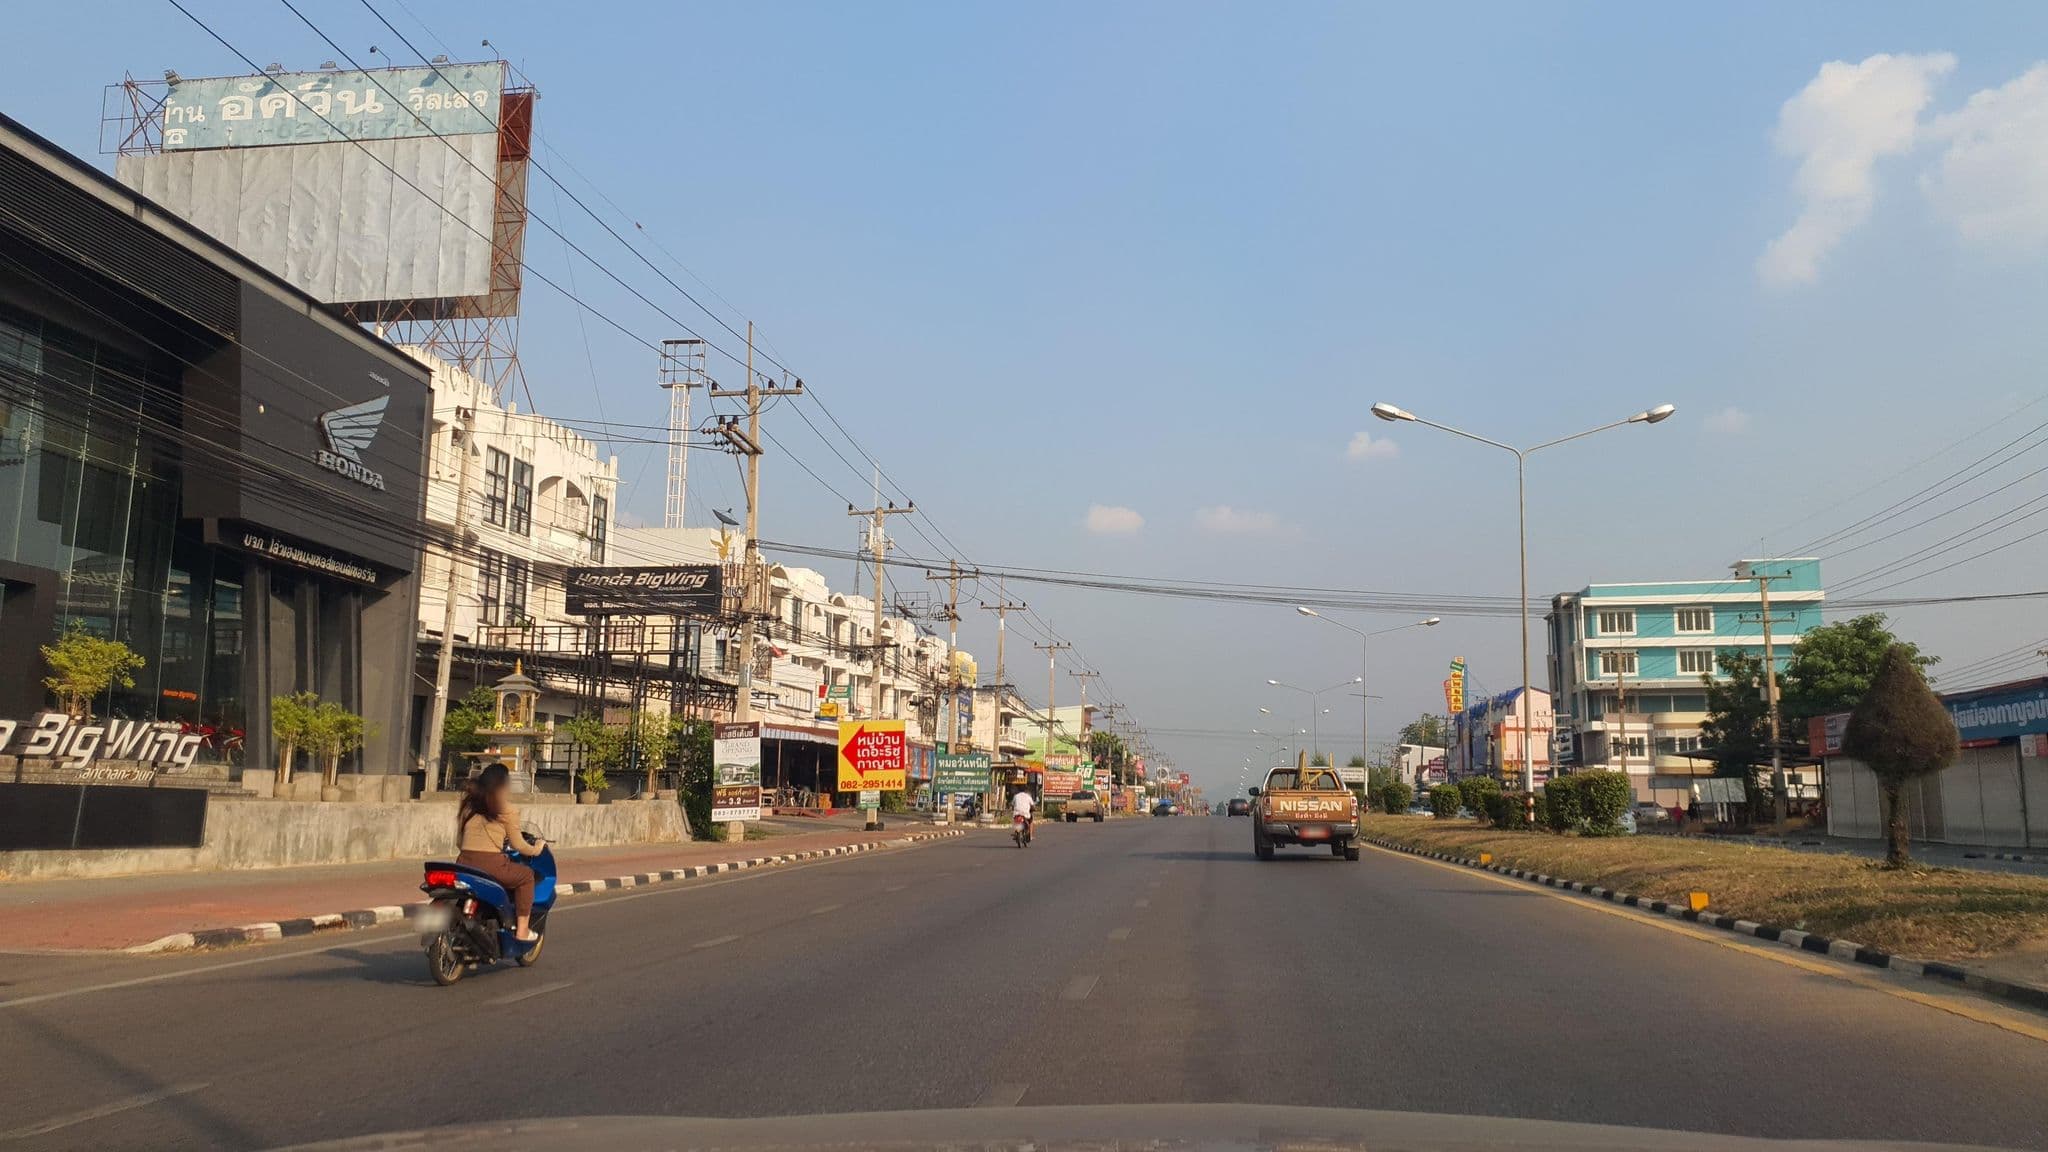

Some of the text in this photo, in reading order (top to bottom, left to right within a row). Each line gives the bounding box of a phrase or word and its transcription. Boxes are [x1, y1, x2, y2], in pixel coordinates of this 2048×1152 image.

[319, 449, 386, 491] HONDA
[575, 573, 633, 586] Honda
[857, 733, 900, 749] หมู่บ้าน
[857, 745, 901, 758] เดอะริช
[857, 757, 901, 770] กาญจน์
[840, 780, 903, 789] 082-2951414
[728, 797, 742, 805] 3.2
[1280, 800, 1343, 812] NISSAN
